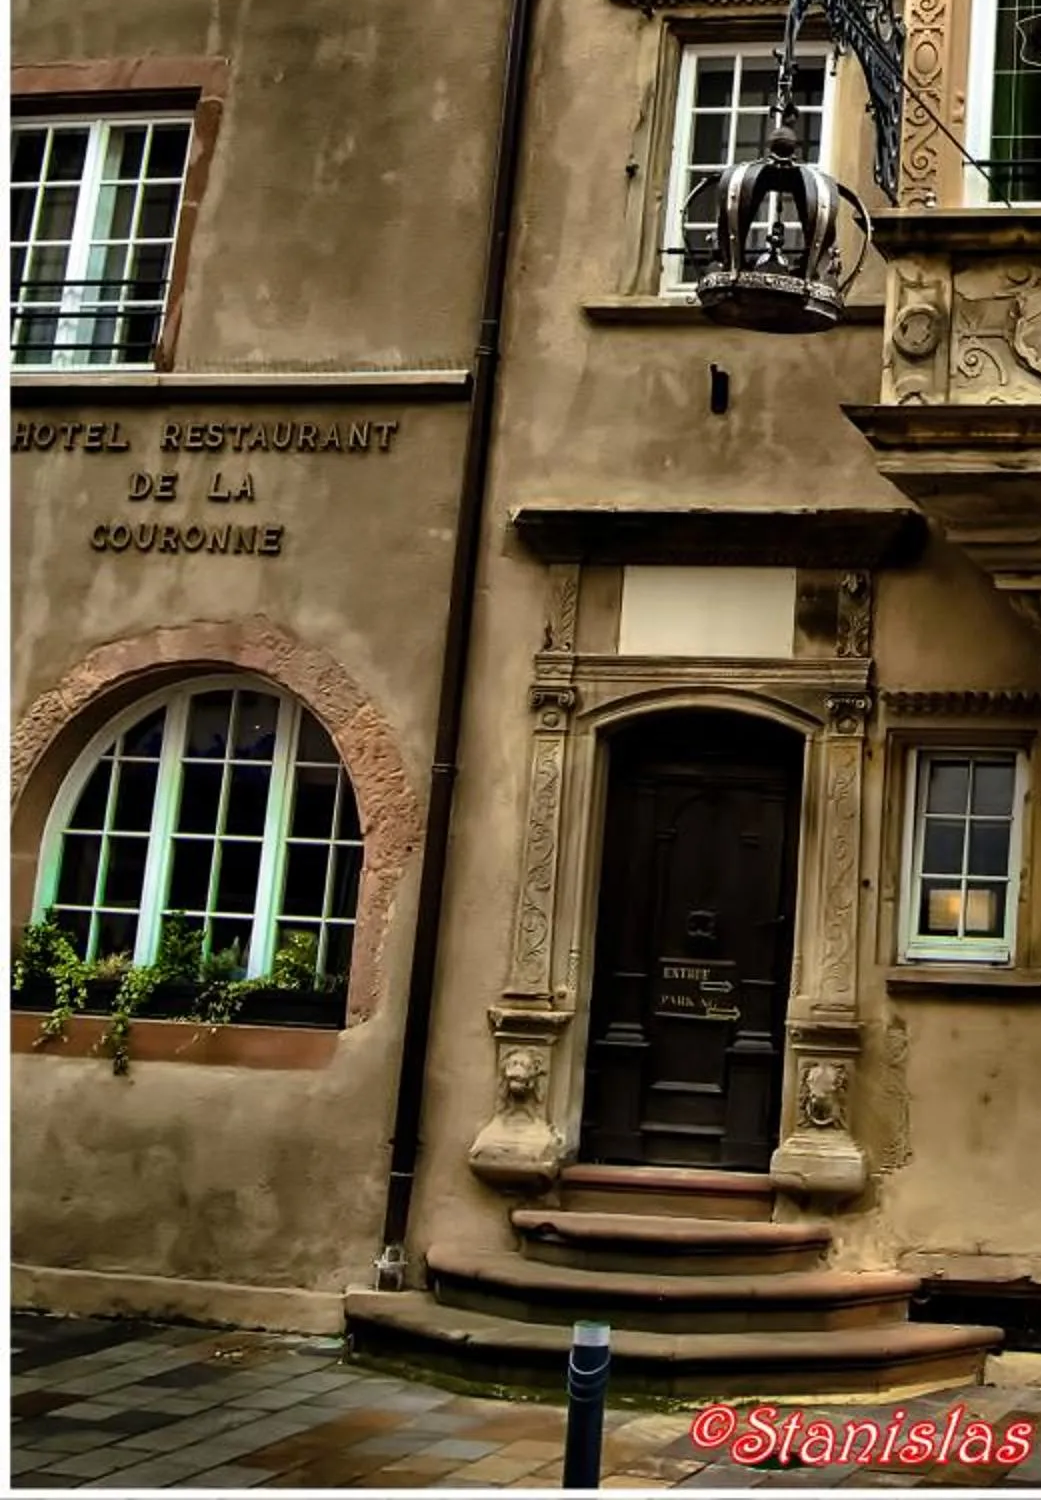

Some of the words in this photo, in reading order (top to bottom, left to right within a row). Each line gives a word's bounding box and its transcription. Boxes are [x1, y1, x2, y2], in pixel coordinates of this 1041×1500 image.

[11, 421, 129, 453] HOTEL
[160, 420, 398, 454] RESTAURANT
[128, 471, 177, 501] DE
[207, 471, 254, 501] LA
[90, 523, 283, 555] COURONNE
